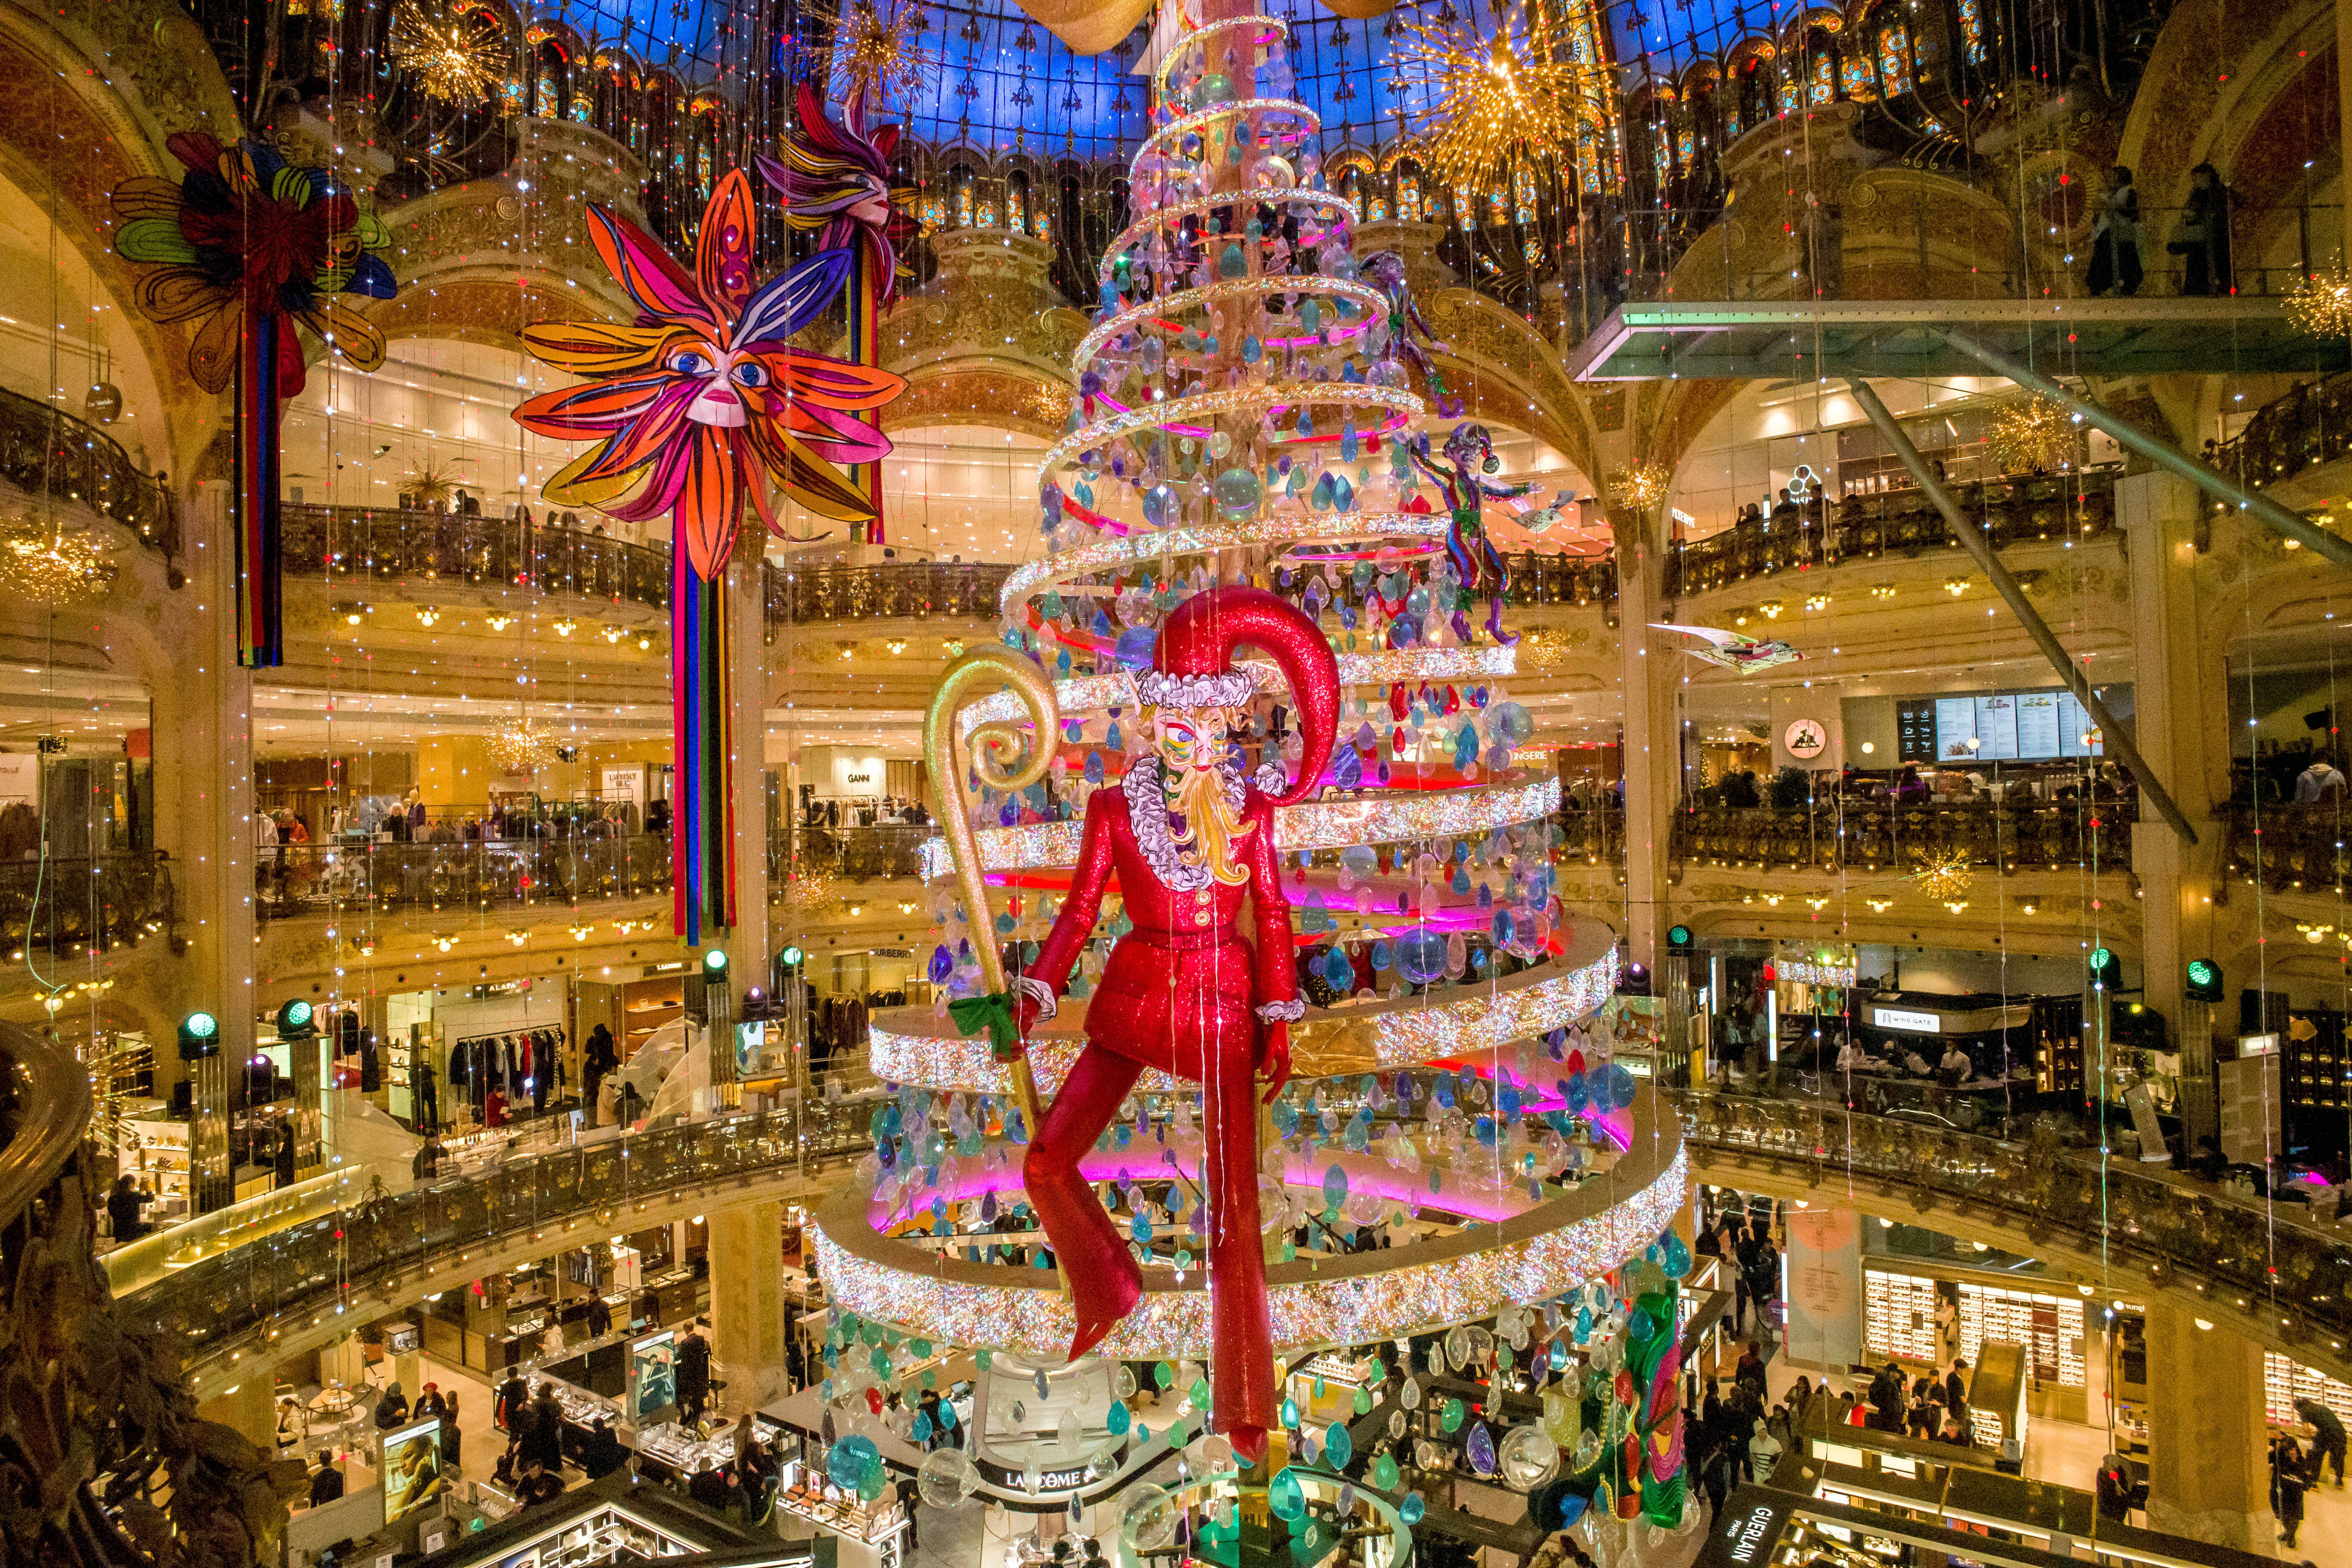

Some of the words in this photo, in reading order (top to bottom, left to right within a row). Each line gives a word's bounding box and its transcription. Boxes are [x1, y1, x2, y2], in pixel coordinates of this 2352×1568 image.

[1513, 751, 1547, 760] INGERIE
[848, 774, 870, 783] GANNI
[2125, 1303, 2145, 1313] sungl
[1007, 1471, 1080, 1488] LACÔME
[1727, 1520, 1742, 1538] PARIS
[1731, 1507, 1773, 1562] GUERLAIN
